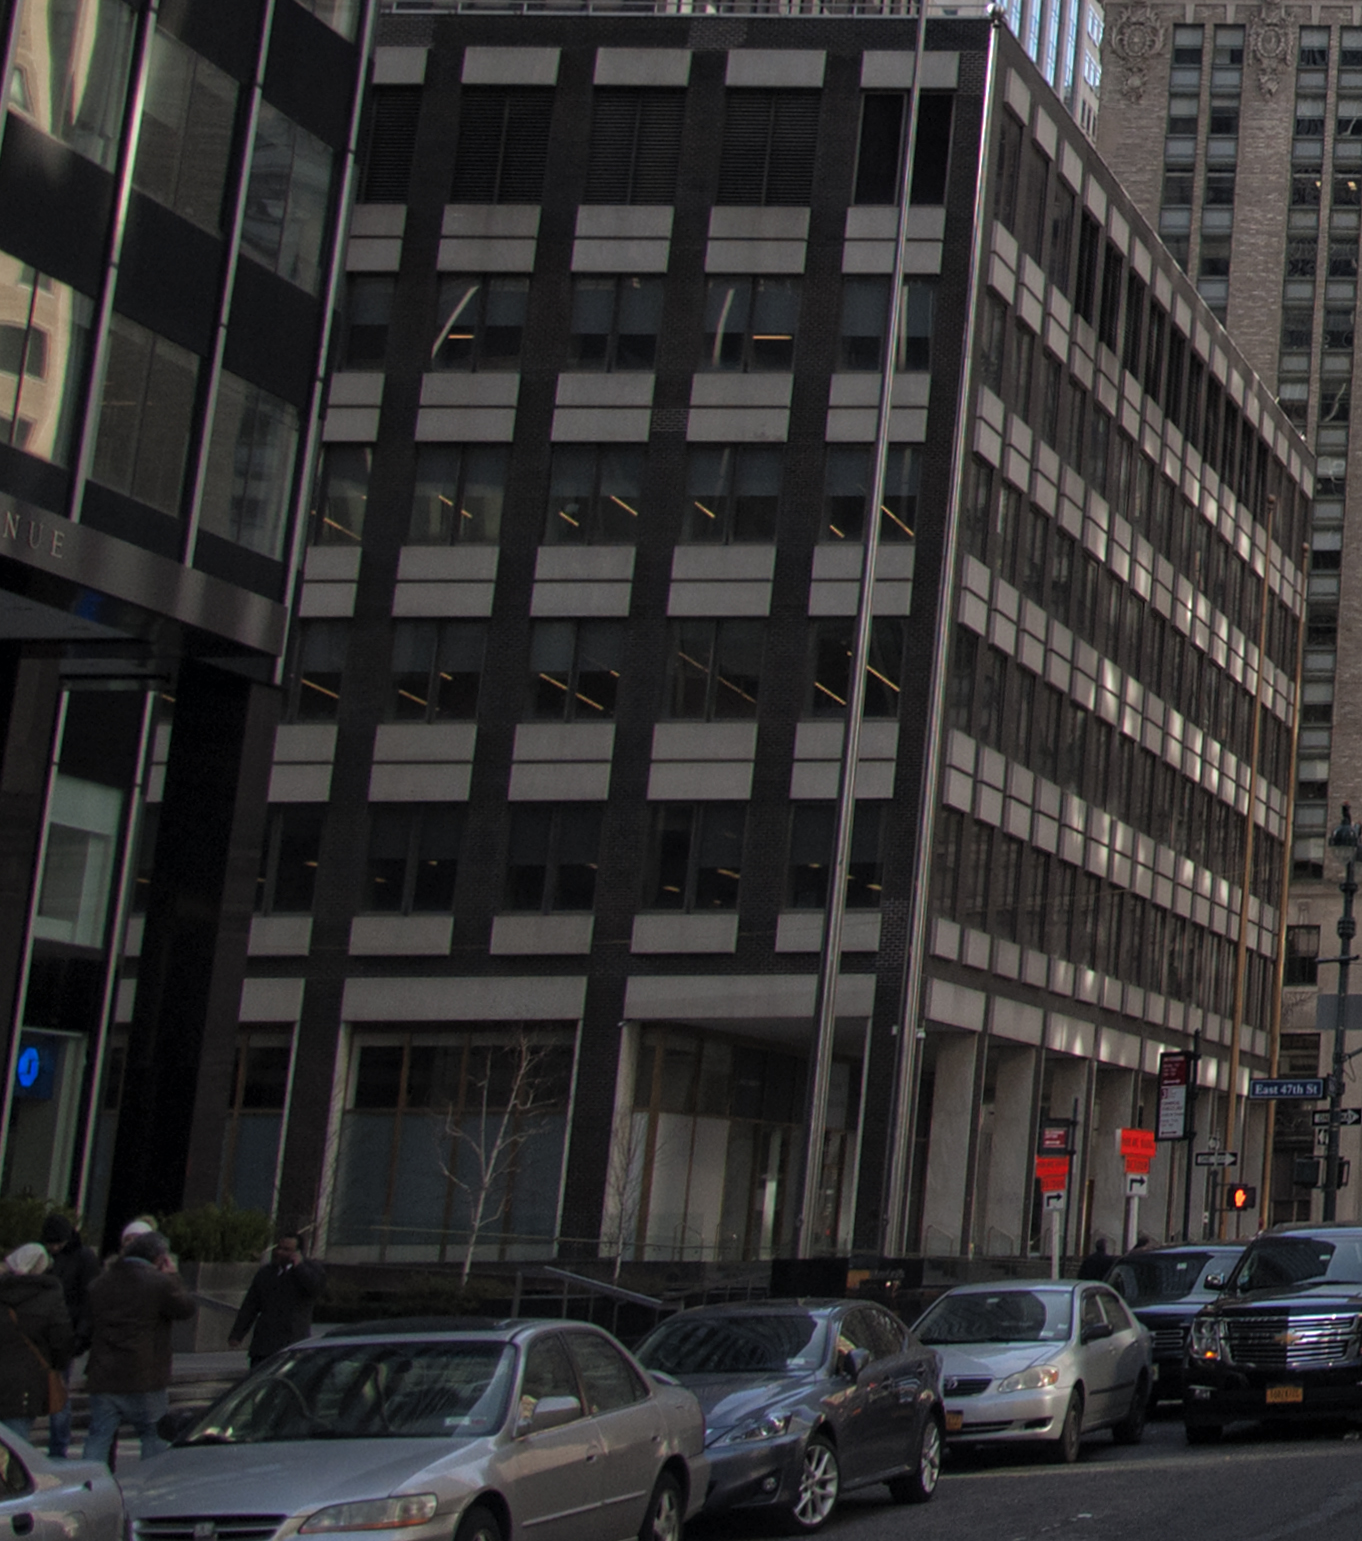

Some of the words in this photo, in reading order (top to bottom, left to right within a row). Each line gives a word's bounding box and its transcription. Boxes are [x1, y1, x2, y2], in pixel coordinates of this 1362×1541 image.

[1255, 1084, 1278, 1094] East
[1280, 1084, 1303, 1094] 47th
[1305, 1083, 1318, 1094] St
